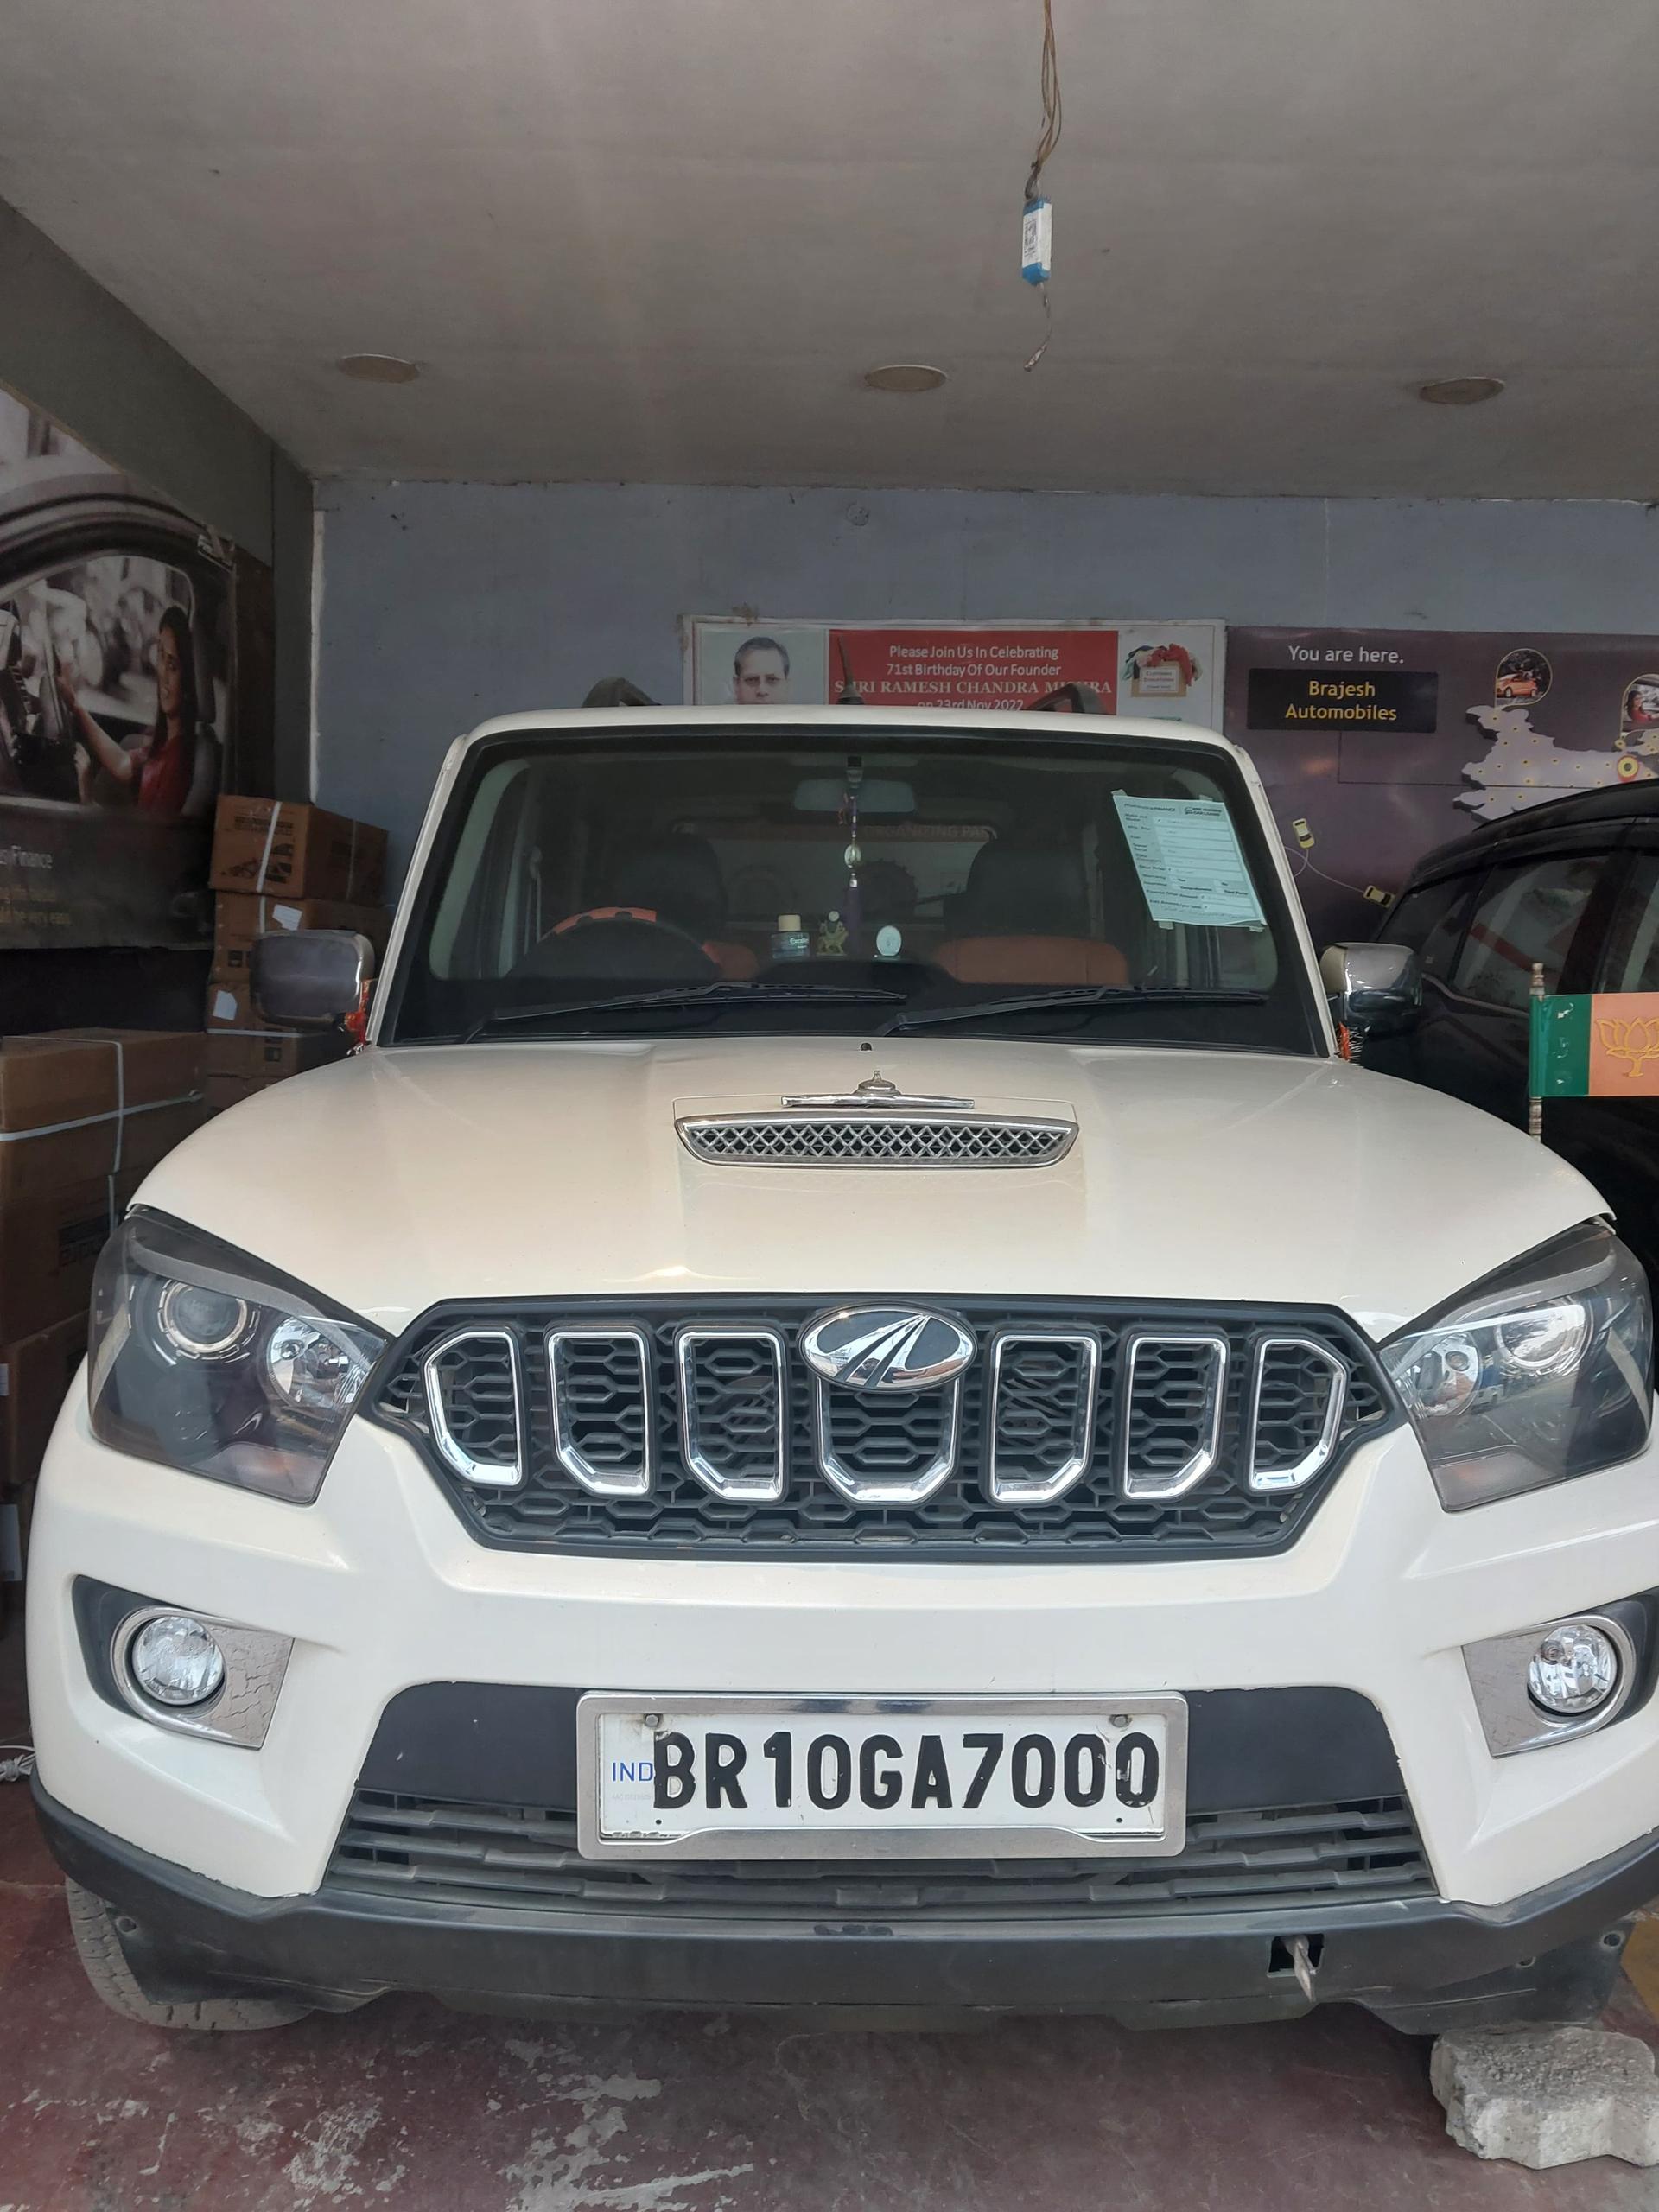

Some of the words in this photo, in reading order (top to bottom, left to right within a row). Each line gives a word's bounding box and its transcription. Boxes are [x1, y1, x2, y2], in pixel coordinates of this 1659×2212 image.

[889, 645, 928, 658] Please
[930, 645, 955, 658] Join
[957, 646, 974, 658] Us
[976, 646, 988, 658] In
[989, 646, 1059, 661] Celebrating
[1288, 645, 1320, 662] You
[1325, 649, 1354, 663] are
[1358, 646, 1405, 664] here.
[887, 663, 913, 676] 71st
[914, 663, 966, 678] Birthday
[967, 664, 983, 676] Of
[985, 664, 1009, 676] Our
[1010, 664, 1062, 676] Founder
[880, 681, 951, 693] RAMESH
[956, 681, 1039, 694] CHANDRA
[1307, 680, 1376, 700] Brajesh
[967, 699, 992, 709] Nov
[994, 699, 1024, 711] 2022
[1284, 703, 1398, 721] Automobiles
[611, 1761, 654, 1782] IND
[652, 1730, 1160, 1810] BR10GA7000
